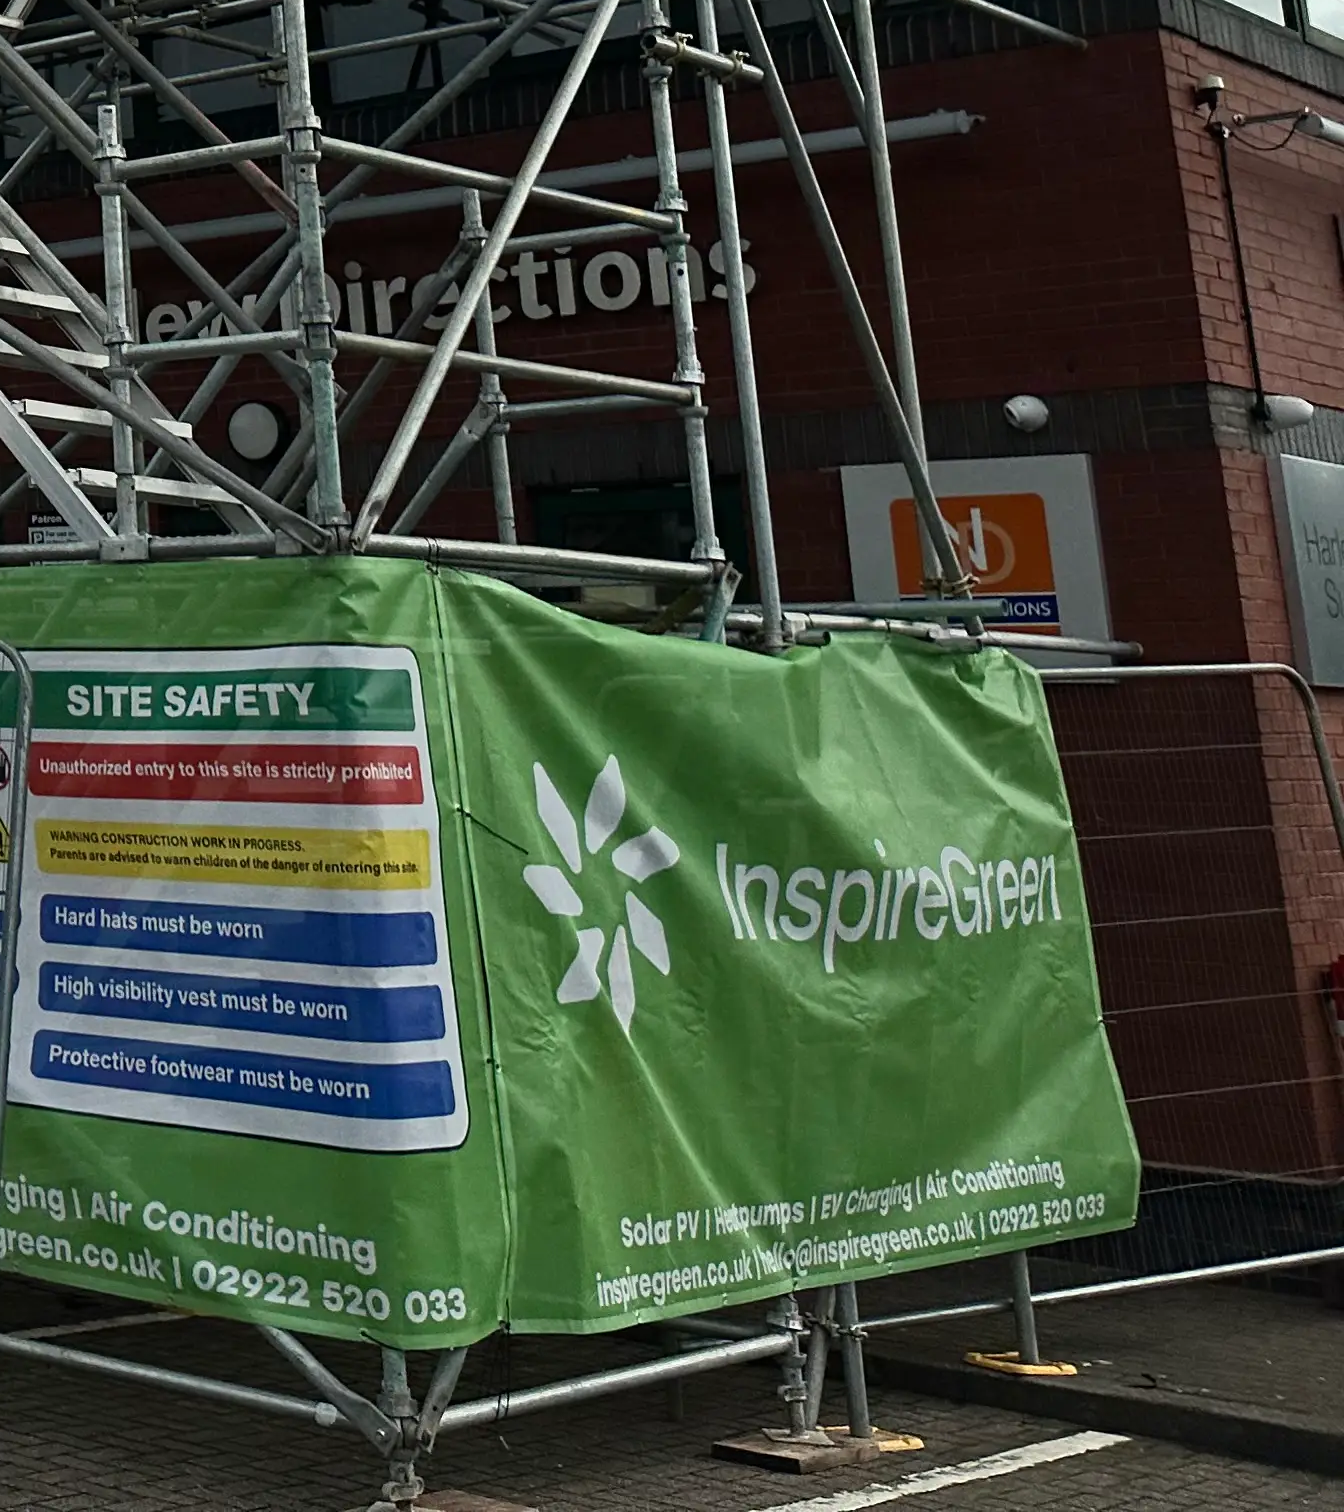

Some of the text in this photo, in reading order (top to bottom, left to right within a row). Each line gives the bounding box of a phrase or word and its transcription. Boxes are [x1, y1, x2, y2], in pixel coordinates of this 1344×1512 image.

[67, 682, 315, 718] SITE SAFETY
[40, 759, 413, 783] Unauthorized entry to this site is strictly prohibited
[50, 830, 306, 852] WARNING CONSTRUCTION WORK IN PROGRESS.
[50, 848, 87, 861] Parents
[89, 852, 106, 862] are
[108, 850, 149, 864] advised
[151, 852, 161, 864] to
[163, 854, 191, 865] warn
[193, 853, 238, 868] children
[240, 855, 251, 868] of
[252, 856, 270, 869] the
[271, 857, 310, 874] danger
[312, 859, 323, 872] of
[324, 860, 381, 877] entering
[383, 861, 400, 874] this
[55, 906, 264, 940] Hard hats must be worn
[716, 839, 1062, 973] InspireGreen
[54, 975, 348, 1021] High visibility vest must be worn
[49, 1045, 370, 1100] Protective footwear must be worn
[620, 1213, 672, 1248] Solar
[677, 1210, 700, 1240] PV
[821, 1192, 843, 1220] EV
[845, 1178, 912, 1216] Charging
[926, 1168, 948, 1200] Air
[952, 1155, 1065, 1195] Conditioning
[90, 1190, 132, 1226] Air
[142, 1199, 377, 1275] Conditioning
[596, 1249, 753, 1312] inspiregreen.co.uk
[757, 1212, 976, 1277] hello@inspiregreen.co.uk
[989, 1205, 1040, 1236] 02922
[1043, 1198, 1072, 1225] 520
[1076, 1193, 1105, 1220] 033
[192, 1260, 310, 1308] 02922
[322, 1280, 390, 1321] 520
[404, 1287, 466, 1324] 033
